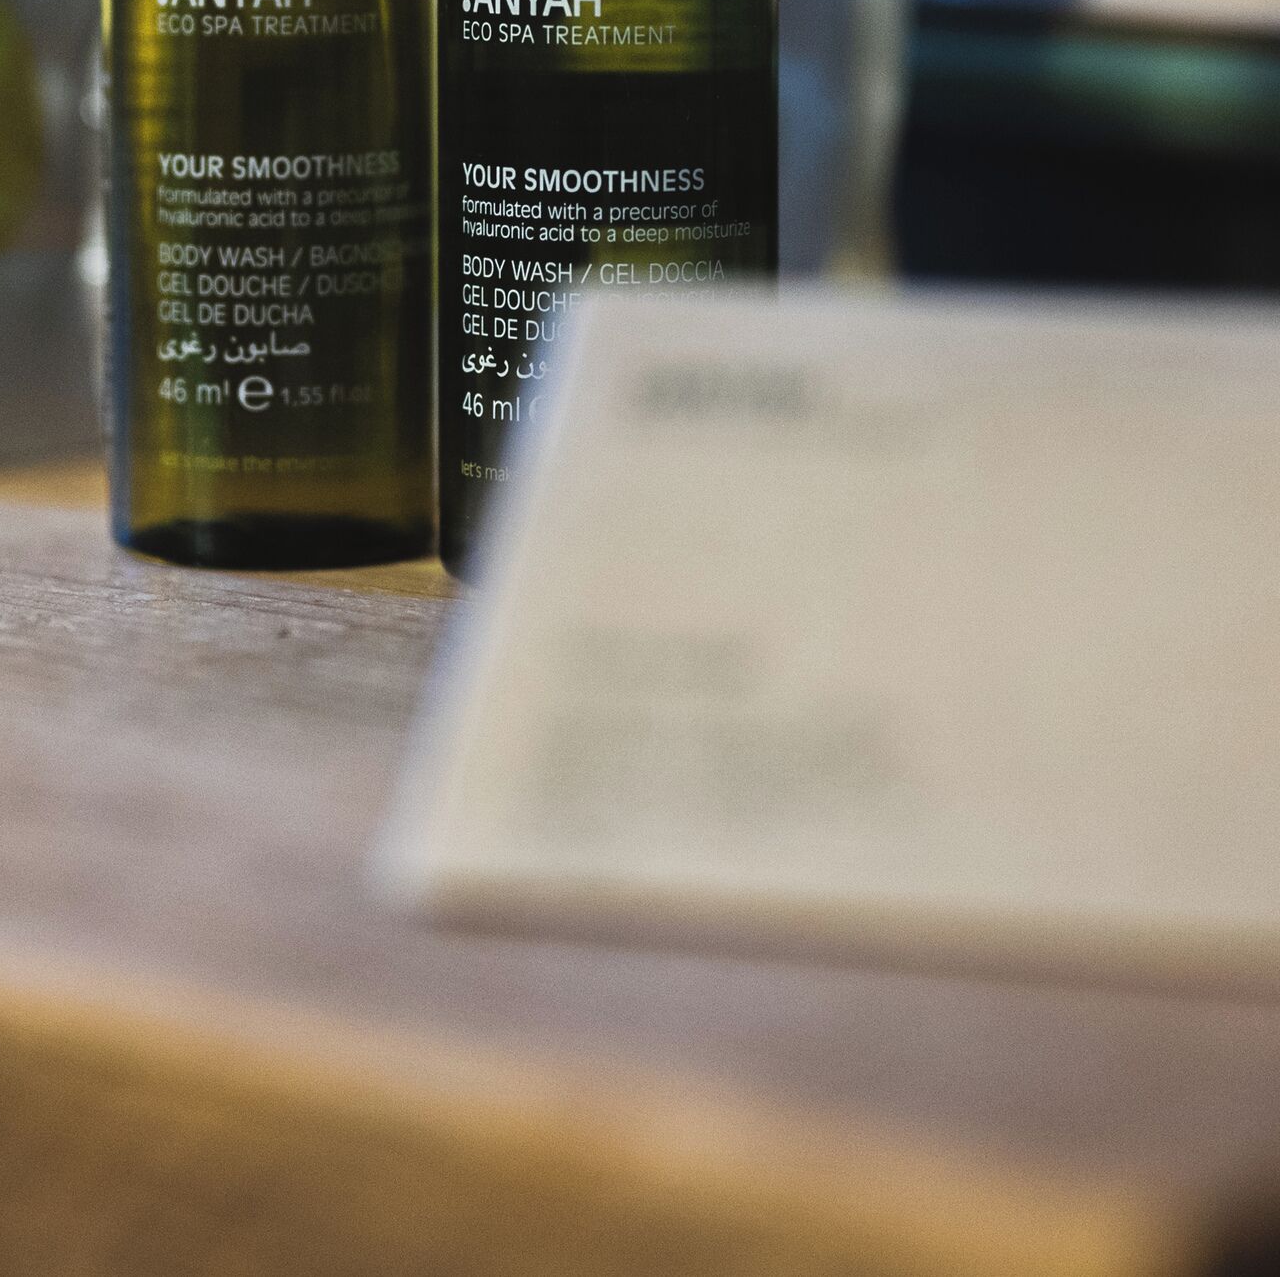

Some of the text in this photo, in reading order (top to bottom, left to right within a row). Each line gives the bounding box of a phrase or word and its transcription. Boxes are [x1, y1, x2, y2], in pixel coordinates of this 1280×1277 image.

[157, 13, 379, 36] ECO SPA TREATMENT
[463, 20, 677, 46] ECO SPA TREATMENT
[158, 150, 401, 180] YOUR SMOOTHNESS
[462, 163, 705, 194] YOUR SMOOTHNESS
[157, 184, 252, 207] formulated
[257, 187, 297, 206] with
[302, 190, 314, 206] a
[158, 206, 244, 229] hyaluronic
[249, 209, 286, 228] acid
[291, 211, 311, 228] to
[316, 212, 326, 227] a
[462, 195, 719, 224] formulated with a precursor of
[462, 216, 751, 245] hyaluronic acid to a deep moisturize
[158, 242, 212, 267] BODY
[217, 246, 285, 268] WASH
[290, 247, 304, 267] /
[462, 254, 725, 285] BODY WASH / GEL DOCCIA
[157, 271, 193, 295] GEL
[197, 274, 291, 297] DOUCHE
[297, 275, 310, 297] /
[462, 283, 489, 308] GEL
[157, 300, 315, 327] GEL DE DUCHA
[462, 312, 489, 337] GEL
[493, 317, 518, 340] DE
[158, 377, 188, 404] 46
[462, 391, 484, 418] 46
[493, 396, 521, 422] ml
